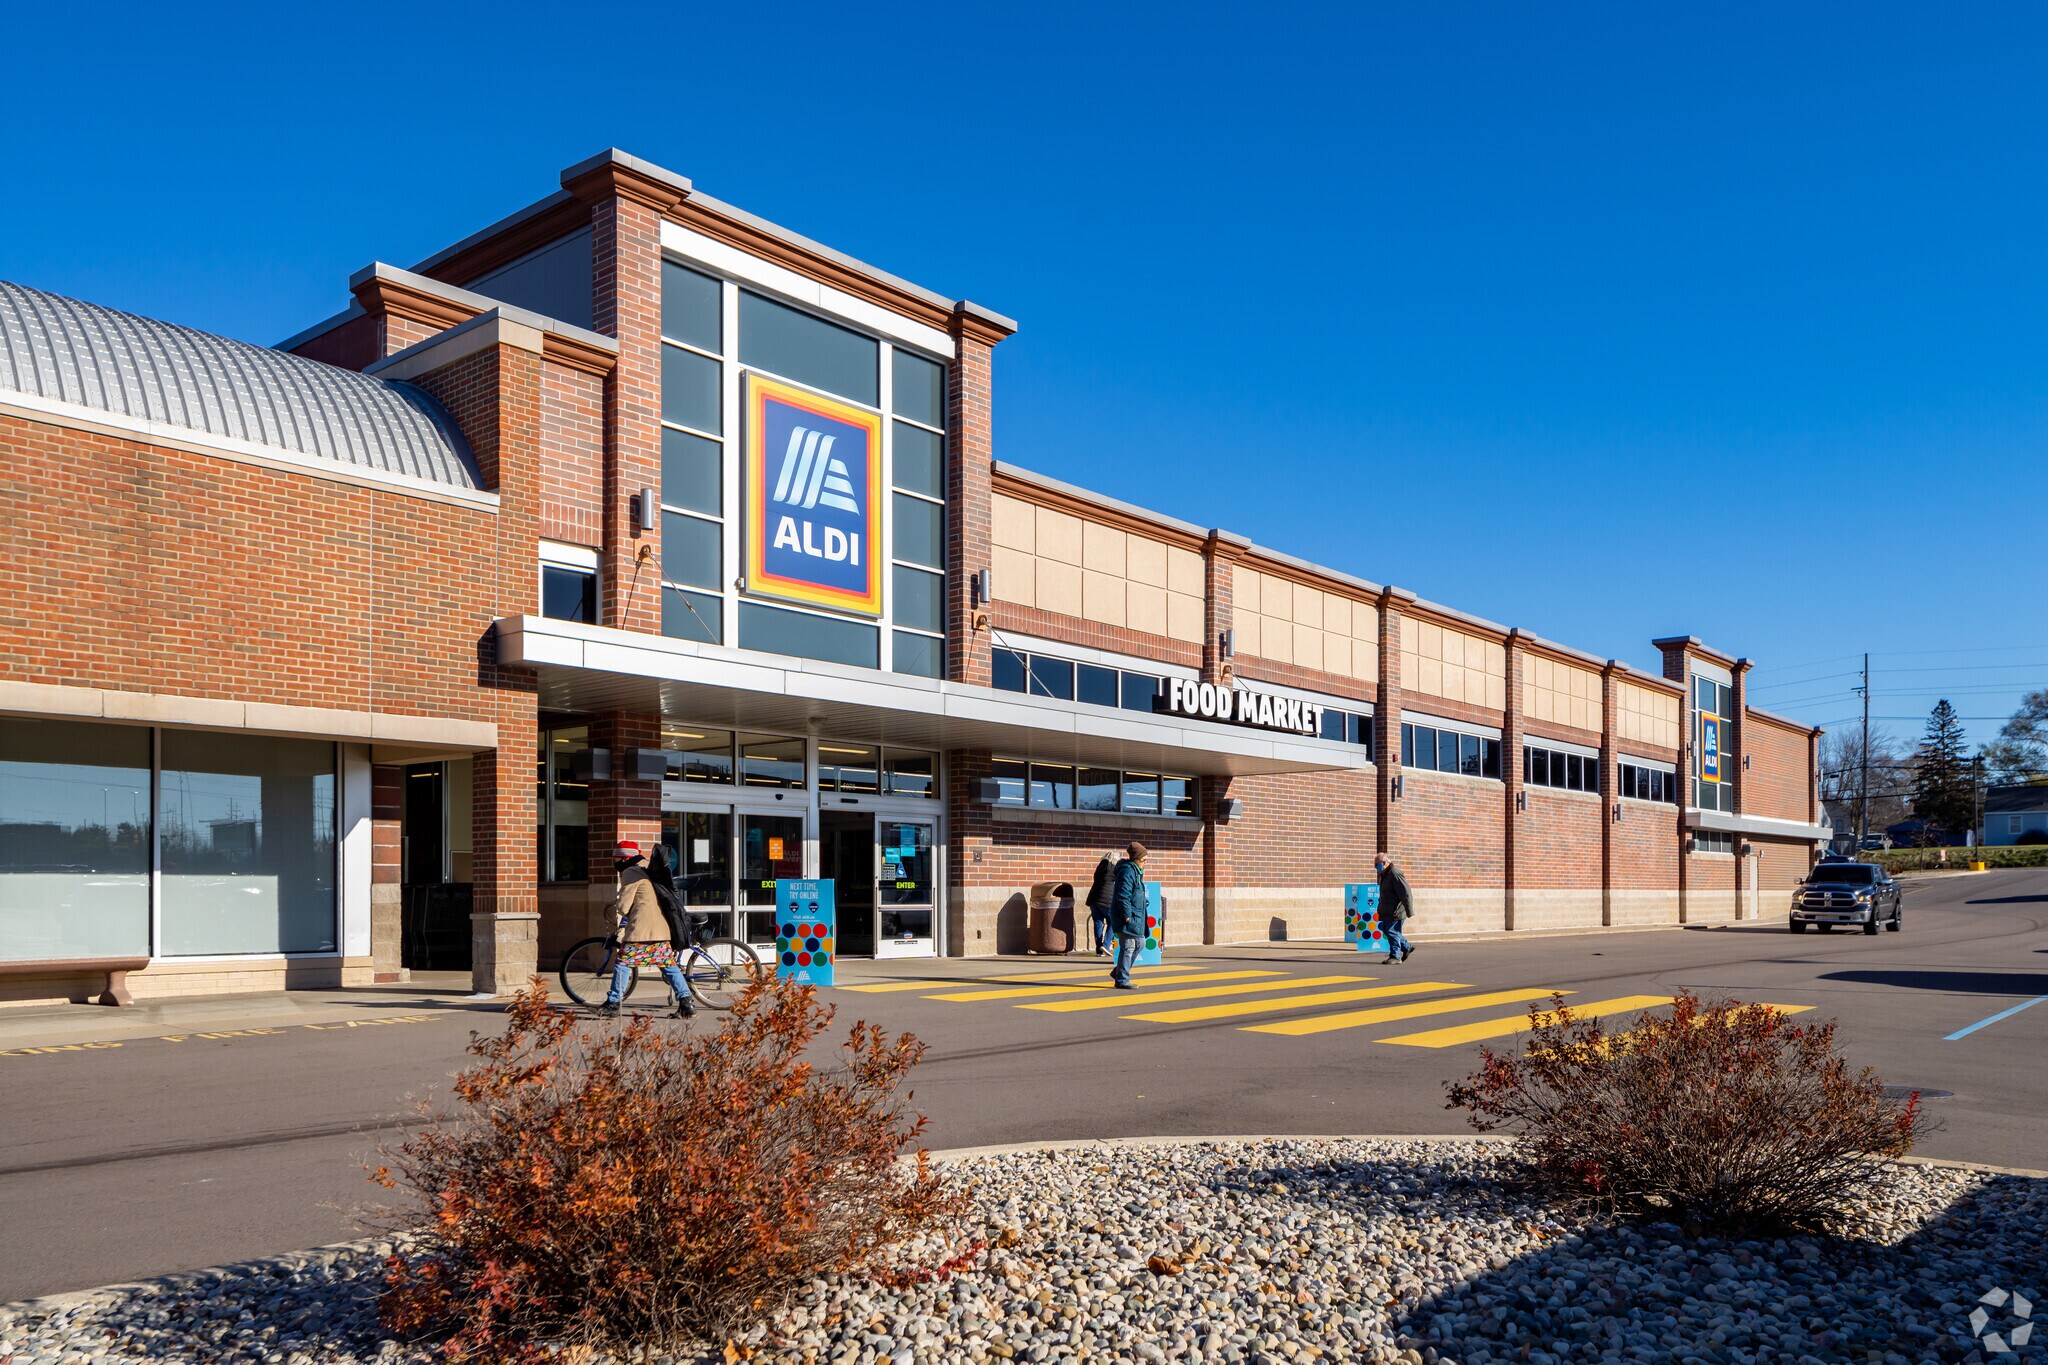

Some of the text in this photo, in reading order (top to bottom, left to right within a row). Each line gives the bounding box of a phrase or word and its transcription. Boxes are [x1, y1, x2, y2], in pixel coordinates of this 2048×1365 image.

[773, 515, 859, 566] ALDI
[1170, 677, 1324, 734] FOOD MARKET
[1705, 754, 1718, 768] ALDI
[789, 882, 802, 890] NEXT
[896, 881, 916, 889] ENTER
[789, 891, 819, 899] TRY ONLINE
[160, 1028, 287, 1042] FIRE
[303, 1015, 442, 1030] LANE
